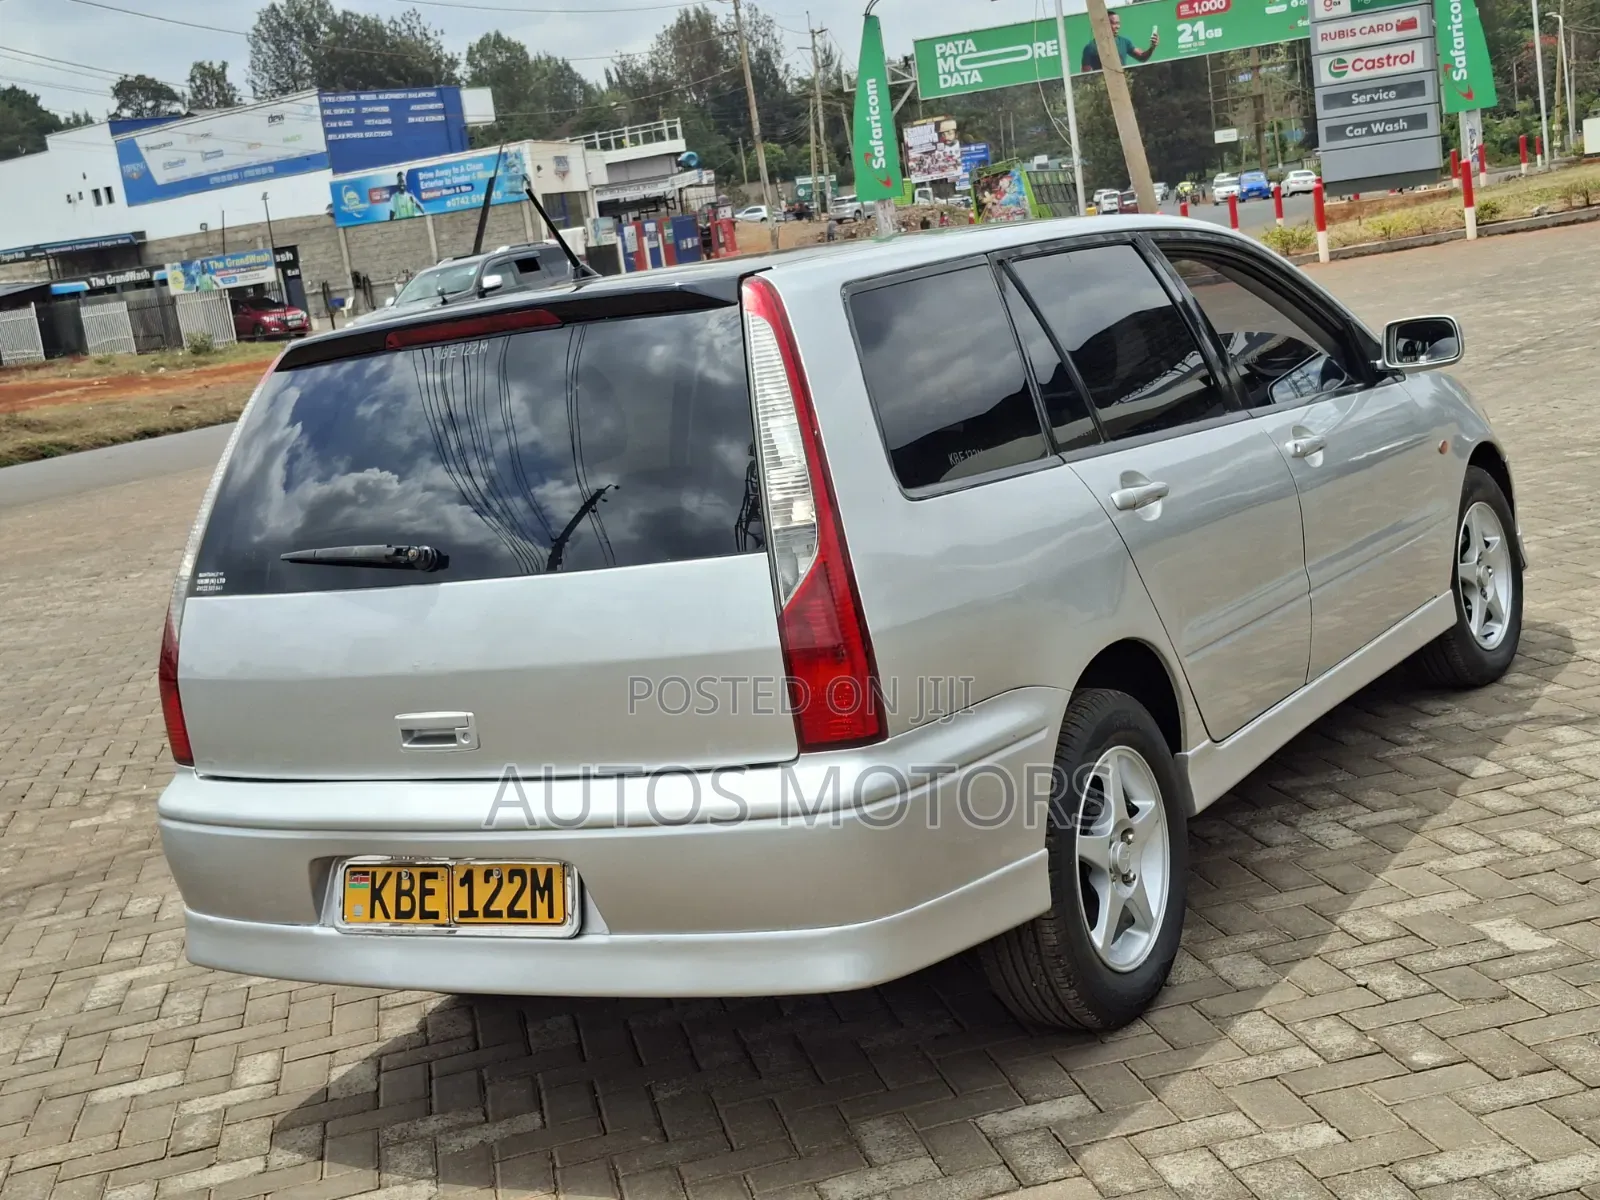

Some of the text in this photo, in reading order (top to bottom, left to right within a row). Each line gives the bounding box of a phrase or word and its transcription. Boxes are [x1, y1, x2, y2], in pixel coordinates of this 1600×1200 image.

[1192, 0, 1226, 14] 1,000
[1321, 22, 1394, 42] RUBIS CARD
[935, 38, 976, 58] PATA
[1352, 50, 1415, 73] Castrol
[939, 70, 983, 89] DATA
[1352, 89, 1396, 104] Service
[865, 78, 886, 169] Safaricom
[1345, 119, 1408, 137] Car Wash
[418, 171, 434, 180] Drive
[209, 252, 270, 270] The GrandWash
[90, 269, 150, 287] The GrandWash
[287, 269, 300, 277] Exit
[460, 341, 489, 357] 122M
[369, 867, 555, 920] KBE 122M
